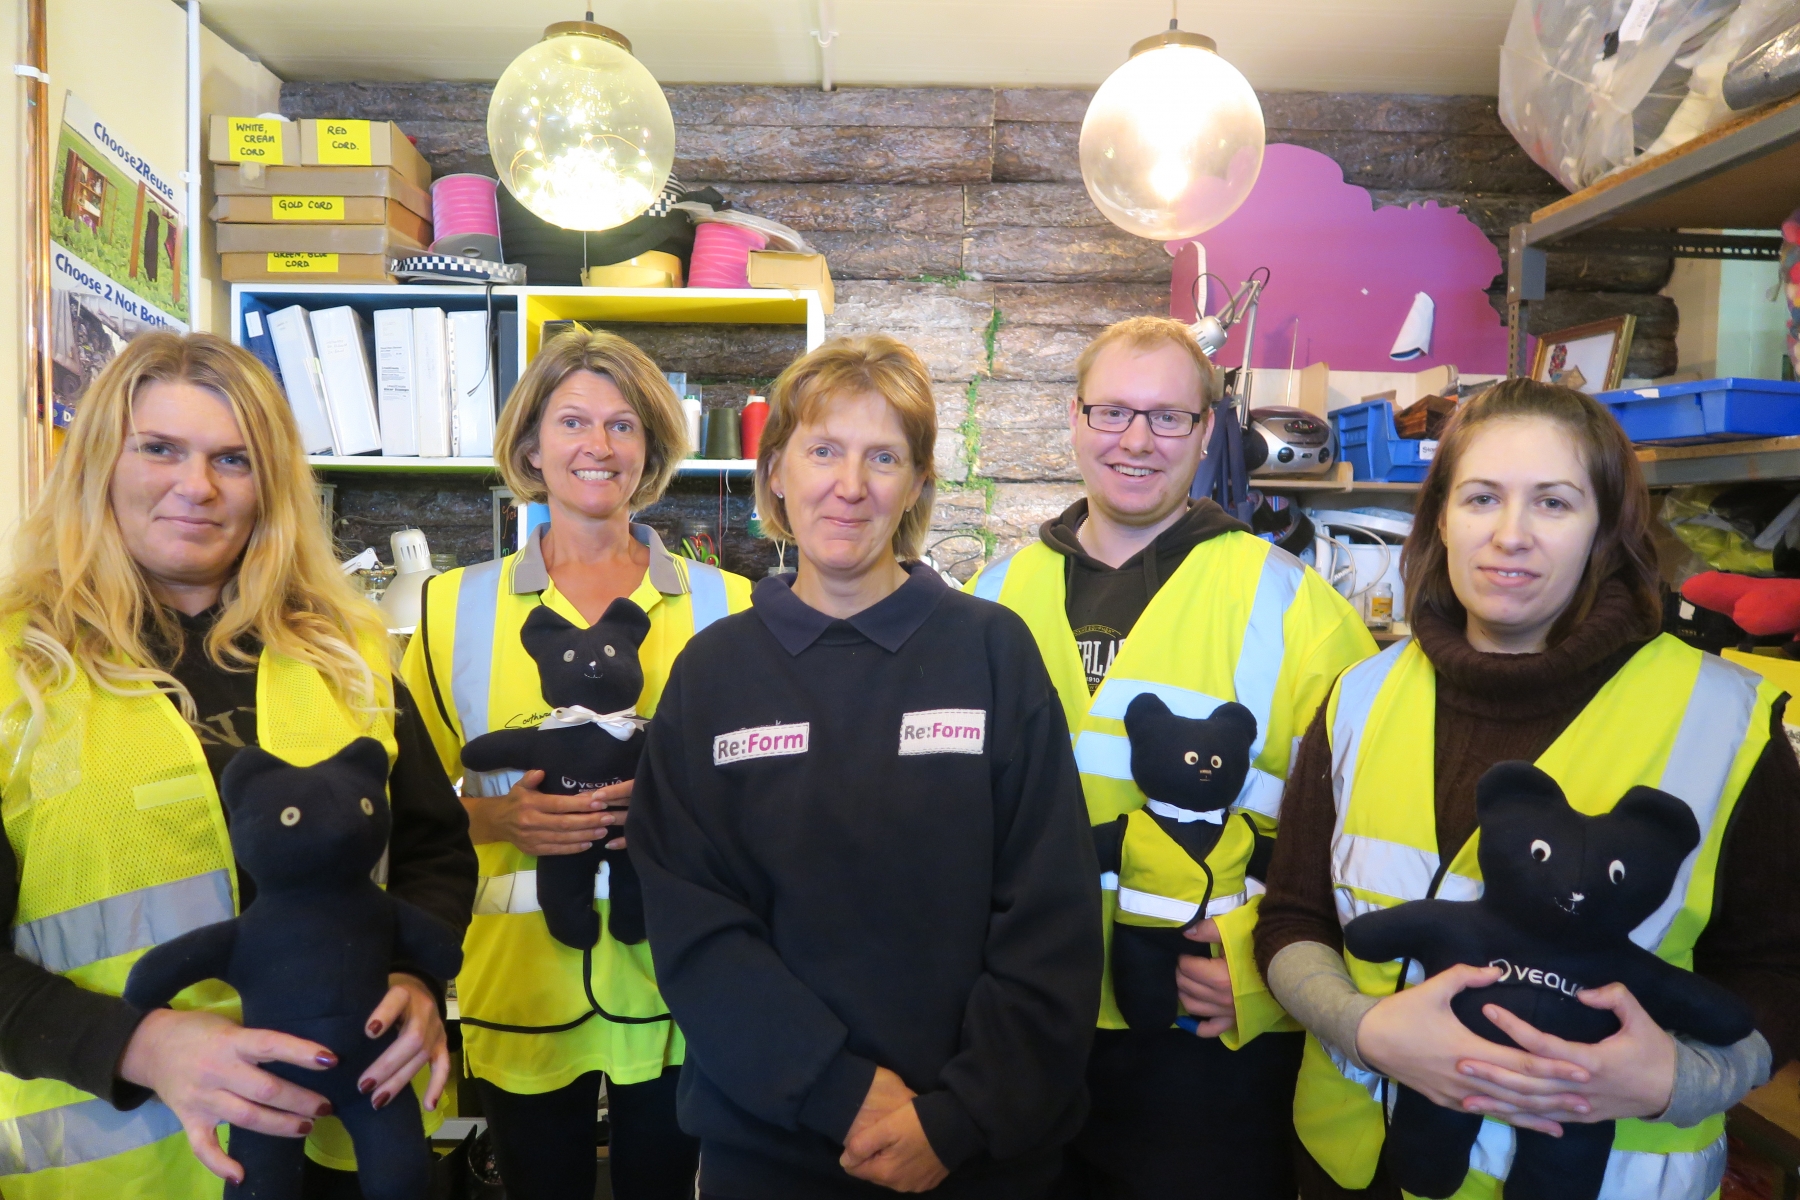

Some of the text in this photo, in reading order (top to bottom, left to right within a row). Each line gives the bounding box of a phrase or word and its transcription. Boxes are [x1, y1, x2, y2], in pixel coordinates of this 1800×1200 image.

[236, 123, 268, 134] WHITE,
[327, 126, 347, 135] RED
[244, 135, 275, 143] CREAM
[240, 147, 265, 156] CORD
[93, 121, 174, 200] Choose2Reuse
[279, 200, 333, 210] GOLD CORD
[285, 260, 310, 268] CORD
[55, 252, 181, 333] Choose 2 Not Both
[904, 722, 981, 740] Re:Form
[717, 733, 804, 760] Re:Form
